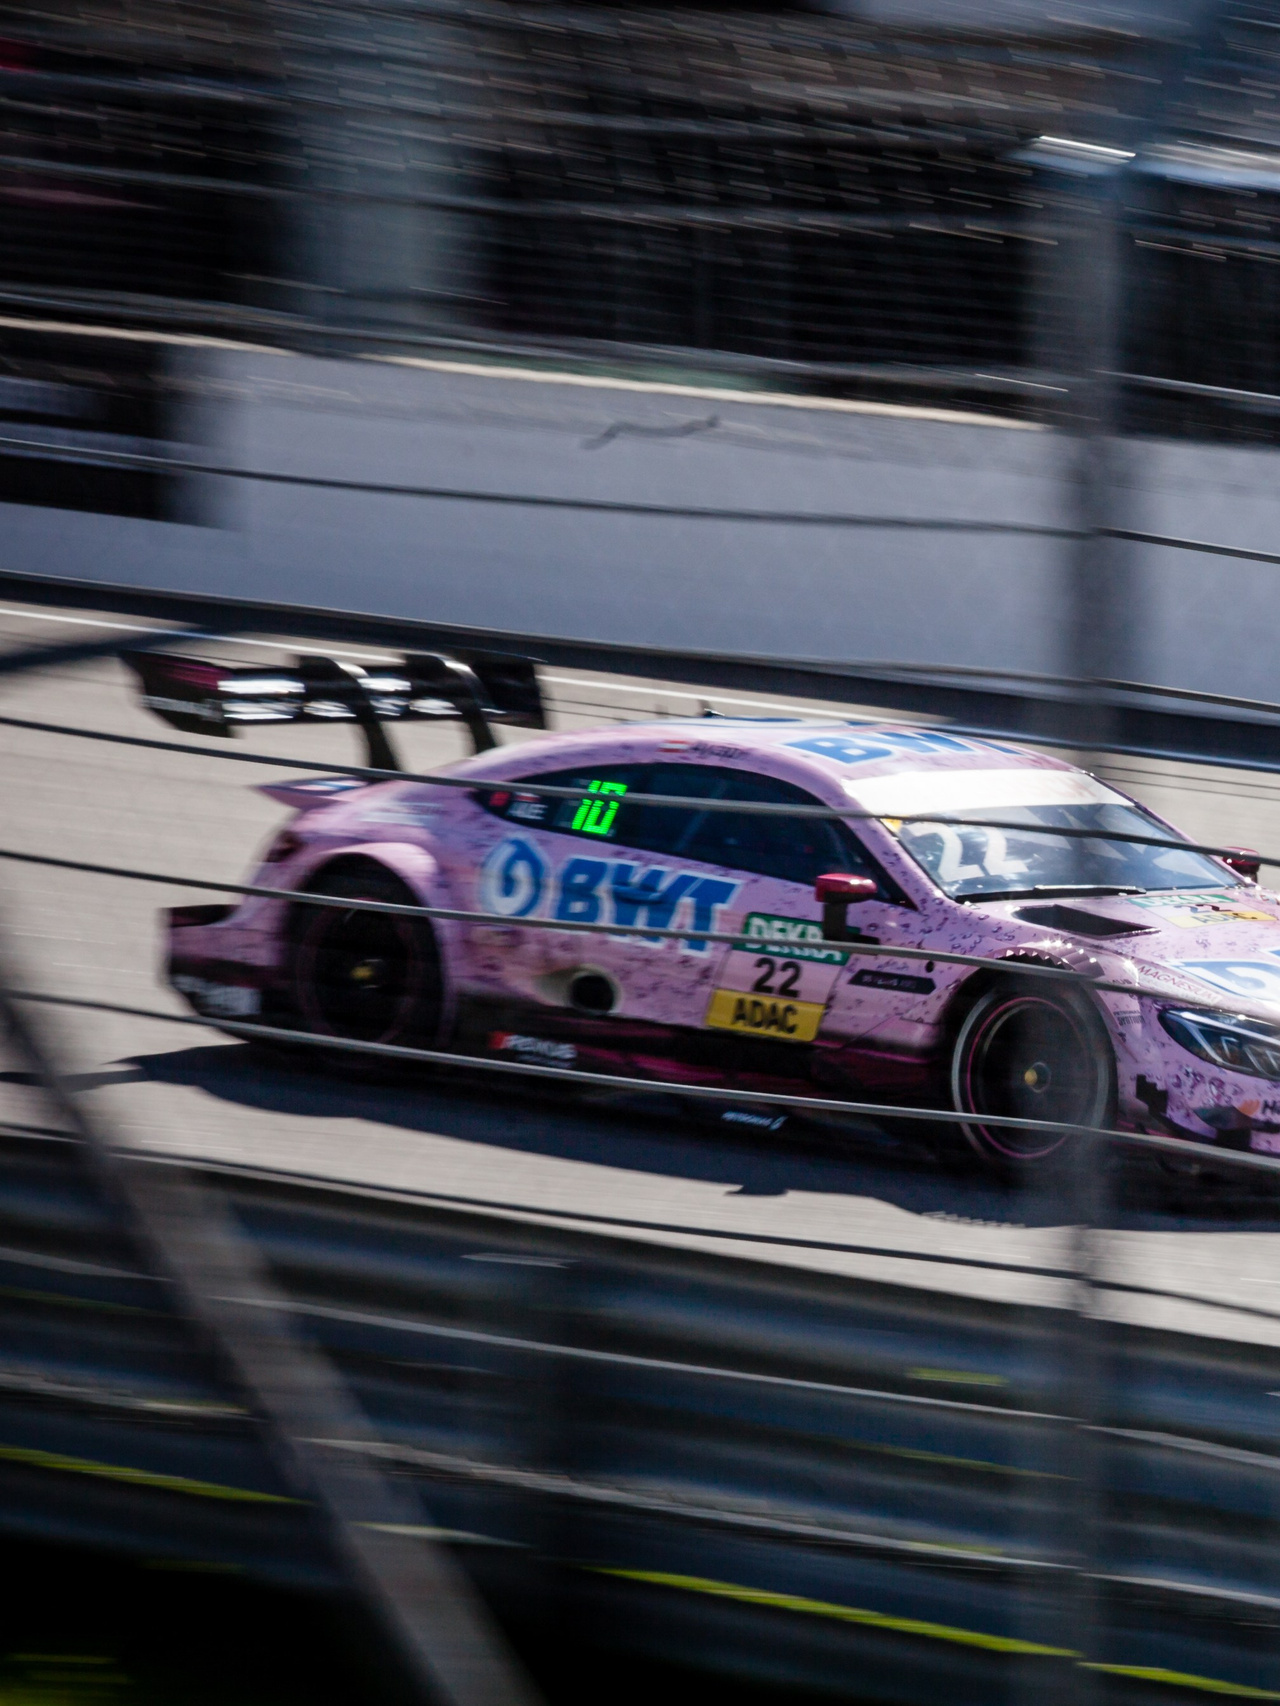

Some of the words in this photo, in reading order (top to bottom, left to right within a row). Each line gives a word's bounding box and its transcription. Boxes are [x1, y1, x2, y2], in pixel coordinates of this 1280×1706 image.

[571, 780, 628, 836] 10
[901, 819, 1030, 883] 22
[553, 855, 740, 955] BWT
[753, 957, 802, 998] 22
[731, 997, 799, 1034] ADAC
